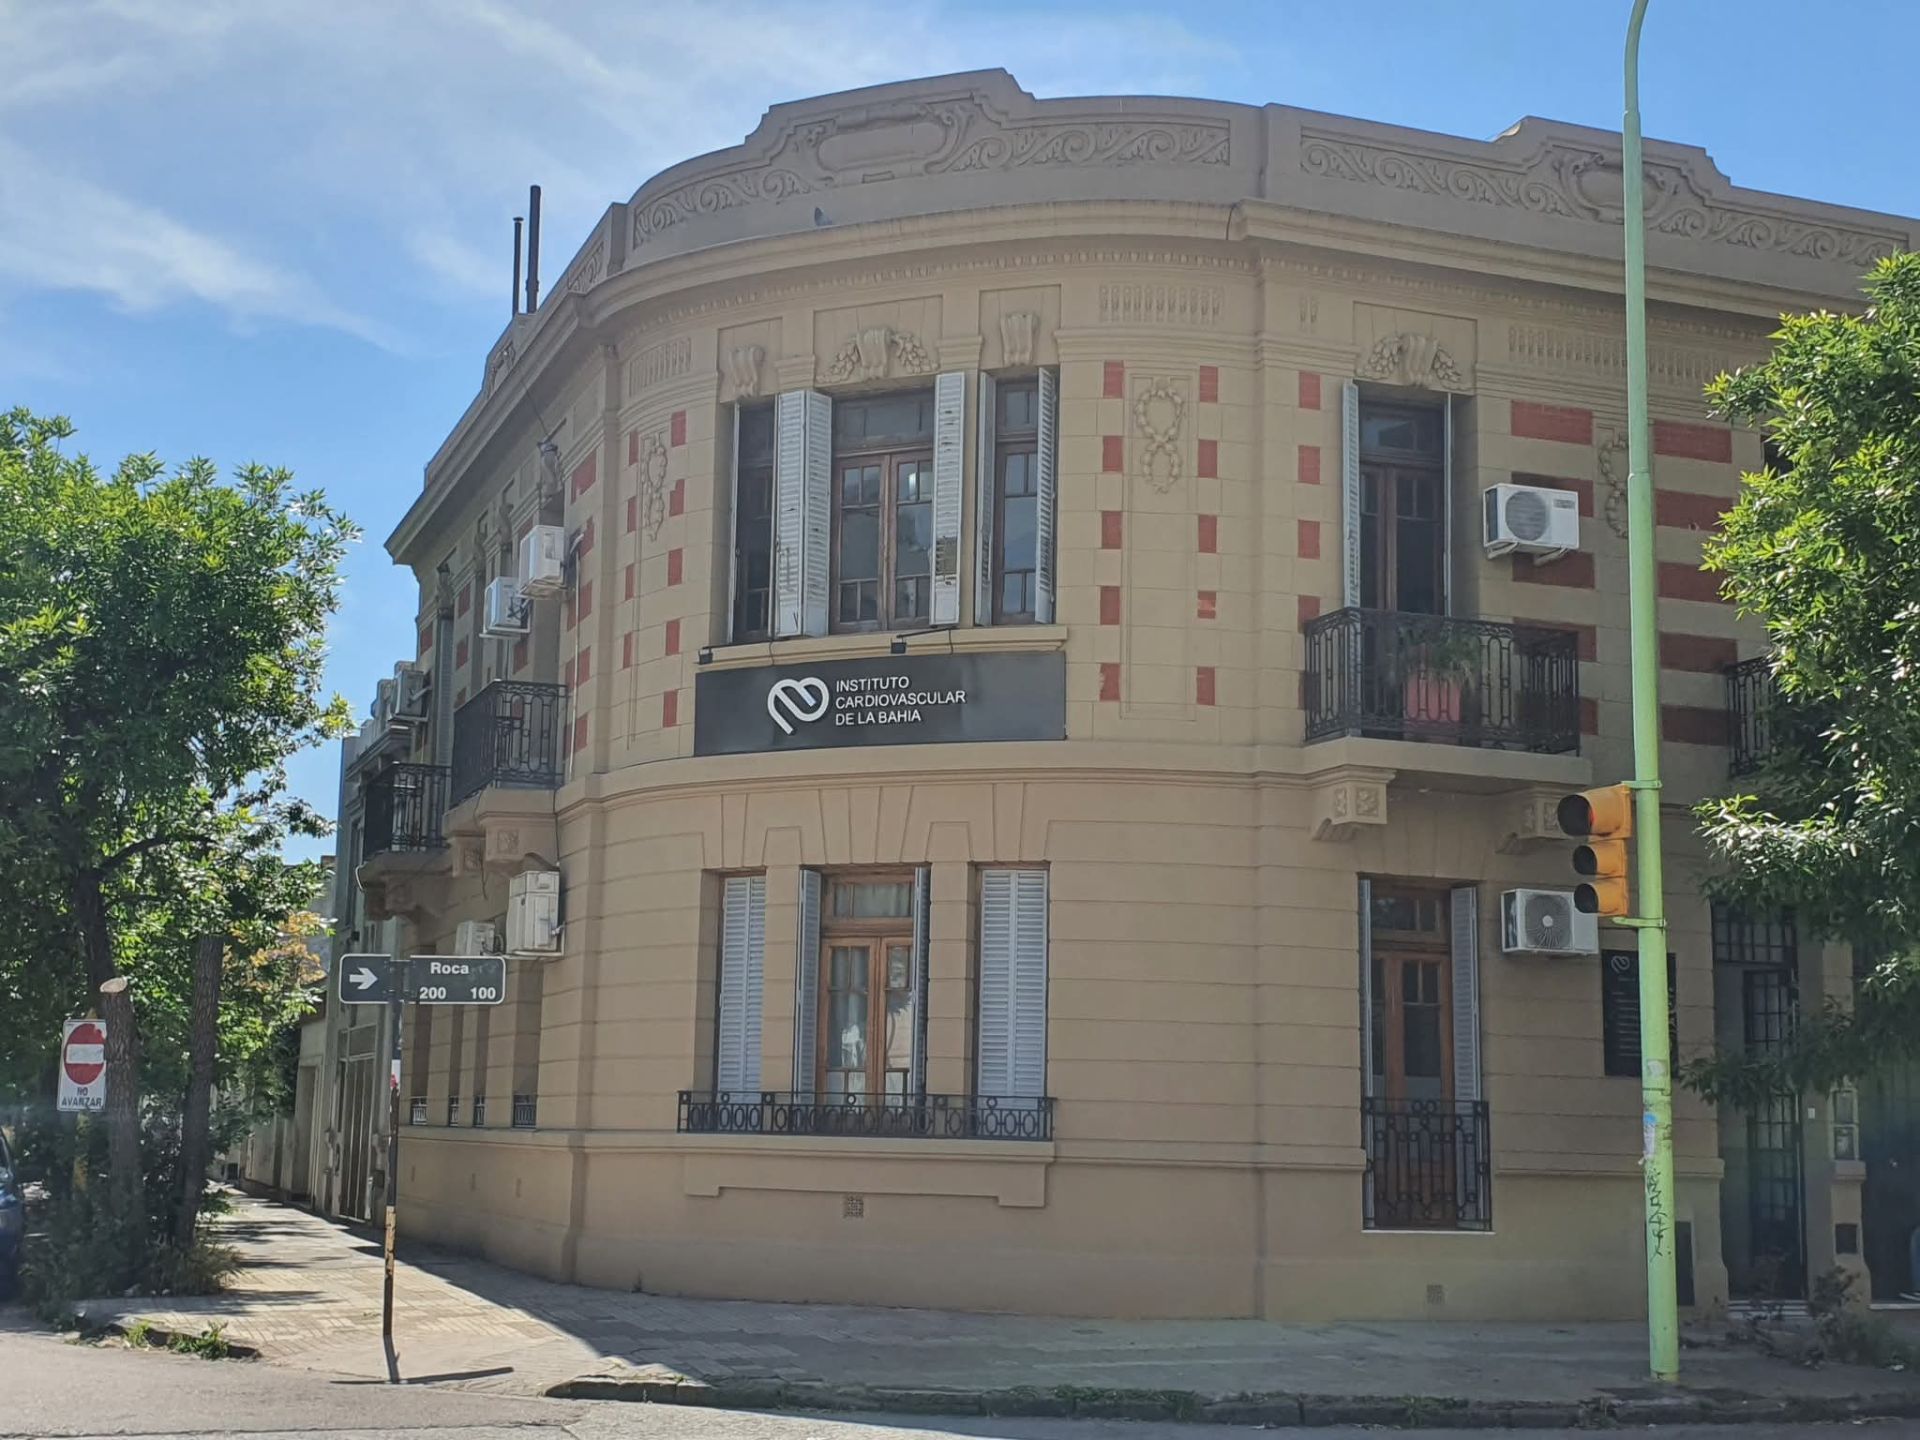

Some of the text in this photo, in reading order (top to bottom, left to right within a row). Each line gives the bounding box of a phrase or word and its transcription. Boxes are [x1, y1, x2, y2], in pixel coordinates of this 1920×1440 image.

[836, 676, 910, 692] INSTITUTO
[835, 690, 966, 710] CARDIOVASCULAR
[835, 709, 921, 726] DE LA BAHIA
[430, 962, 470, 974] Roca
[419, 987, 496, 999] 200 100
[77, 1087, 89, 1096] NO
[61, 1097, 103, 1107] AVANZAR
